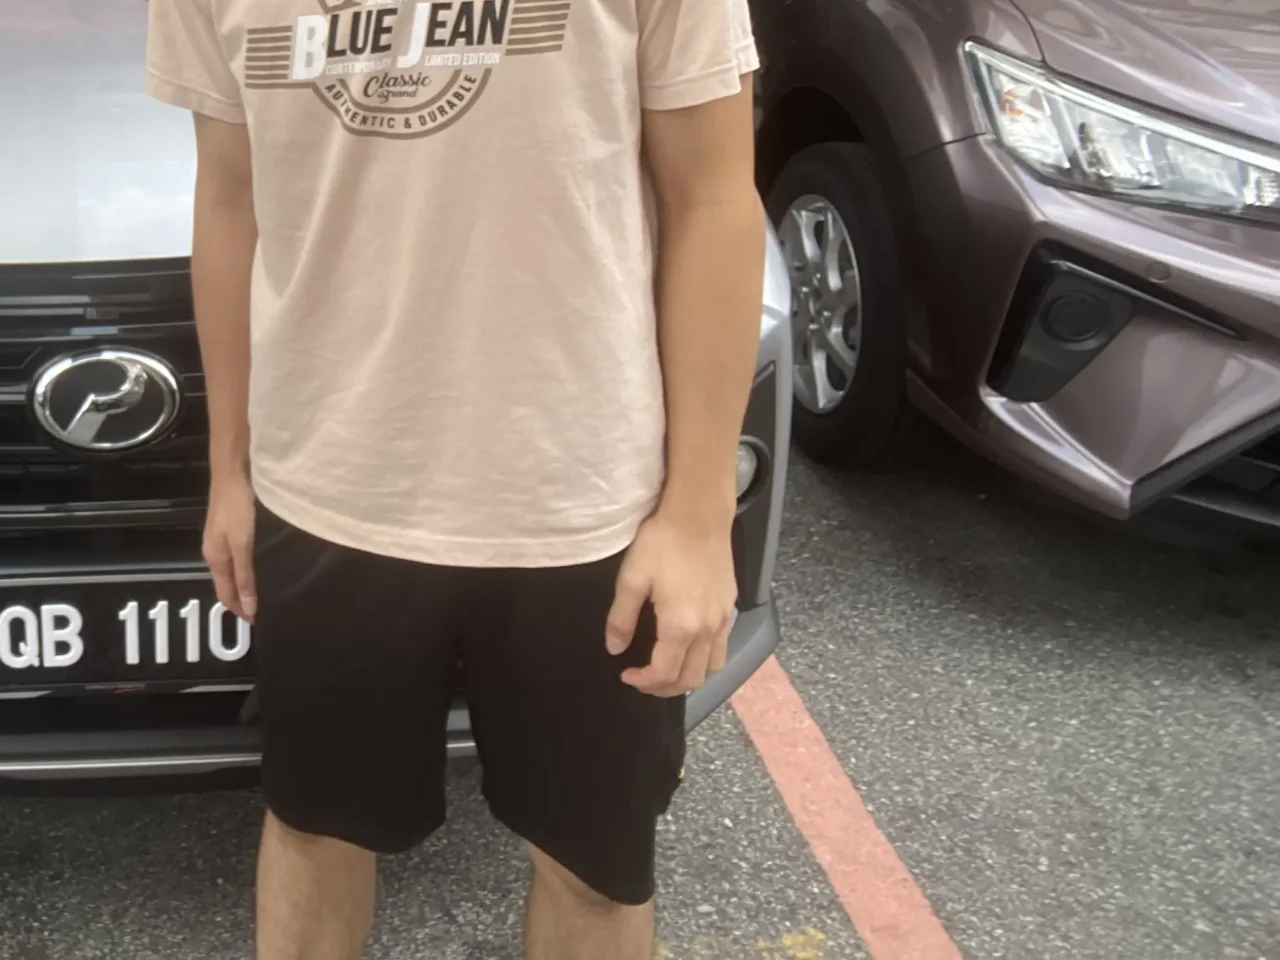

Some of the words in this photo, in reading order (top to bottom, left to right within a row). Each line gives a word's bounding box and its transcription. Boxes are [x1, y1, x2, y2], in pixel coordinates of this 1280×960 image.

[292, 8, 398, 80] BLUE
[425, 53, 462, 66] LIMITED
[463, 52, 501, 65] EDITION
[325, 83, 396, 129] AUTHENTIC
[404, 117, 412, 129] &
[418, 74, 477, 127] DURABLE
[363, 72, 432, 99] Classic
[118, 598, 252, 664] 1110
